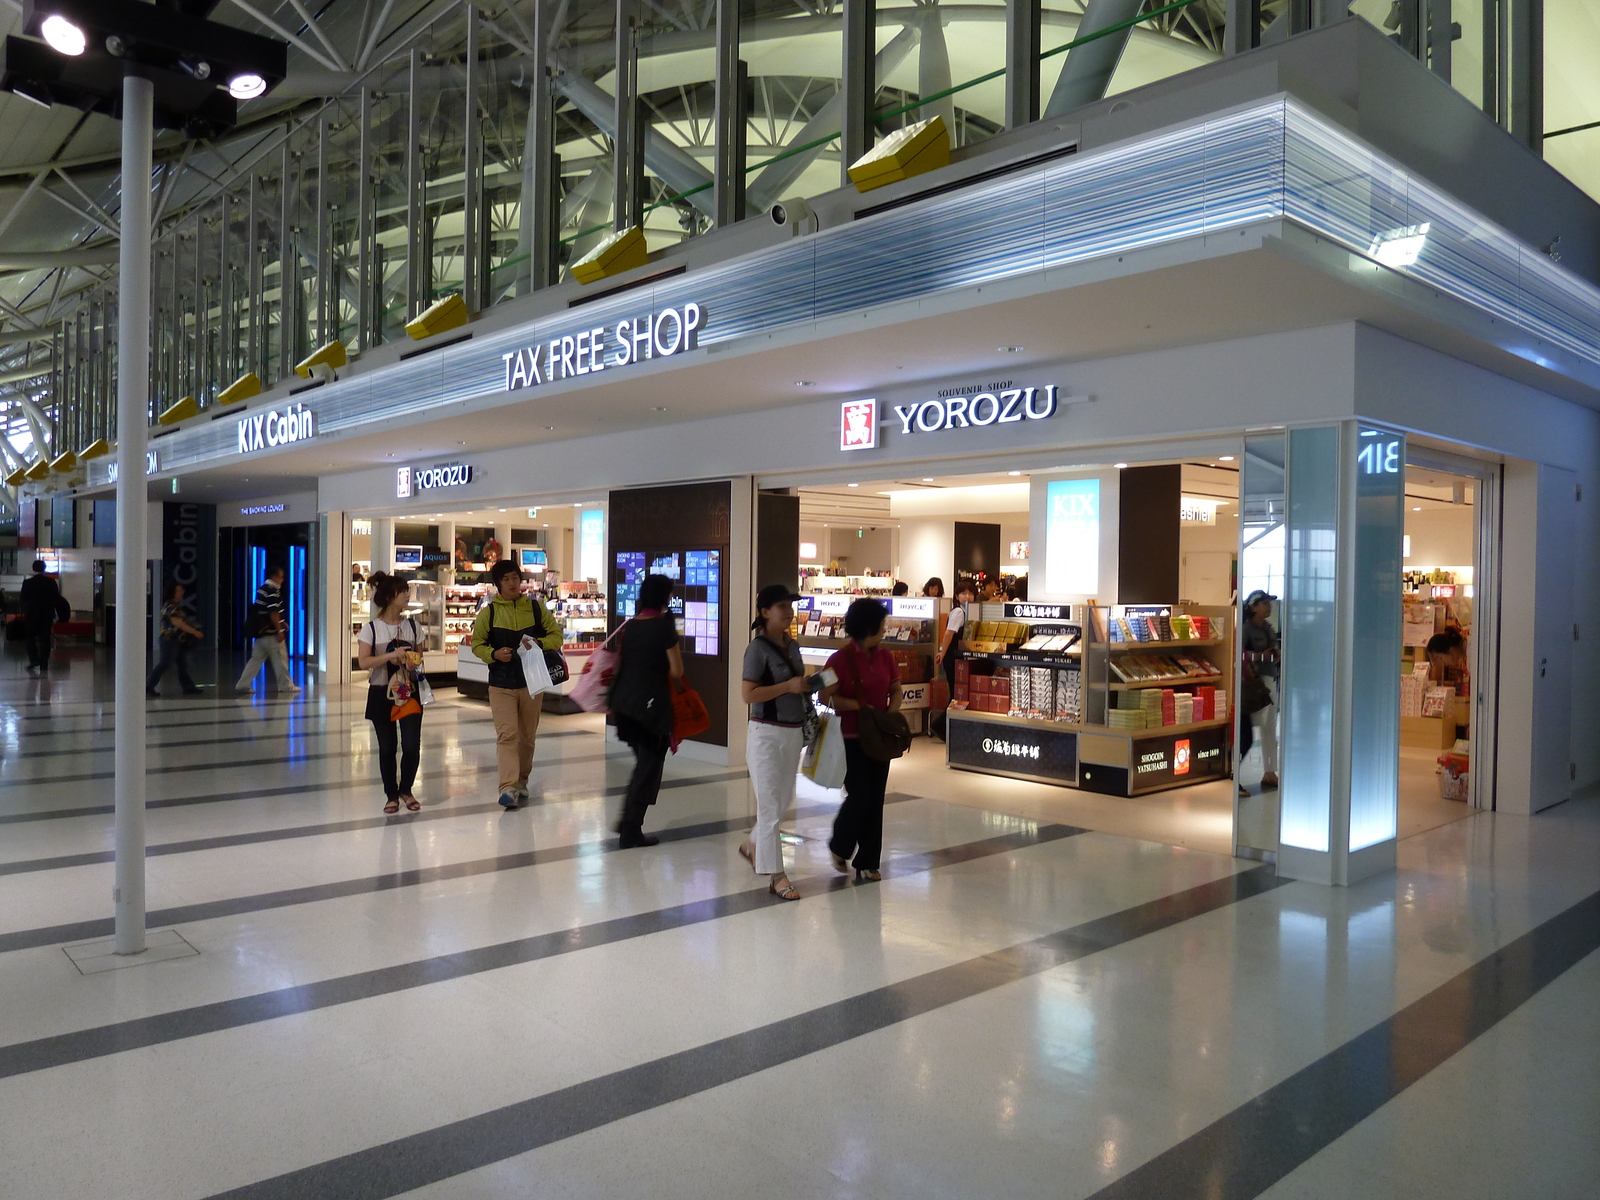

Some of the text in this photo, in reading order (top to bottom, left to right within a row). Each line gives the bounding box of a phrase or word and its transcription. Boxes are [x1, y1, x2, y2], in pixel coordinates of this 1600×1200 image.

[502, 302, 700, 391] TAX FREE SHOP
[937, 380, 1013, 399] SOUVENIR SHOP
[894, 384, 1057, 434] YOROZU
[238, 402, 313, 454] KIX Cabin
[415, 464, 470, 489] YOROZU
[1053, 494, 1096, 517] KIX
[173, 503, 198, 584] Cabin
[424, 554, 447, 562] AQUOS
[1141, 751, 1165, 763] SHOGOIN
[1197, 751, 1209, 759] since
[1137, 761, 1168, 774] YATSUHASHI
